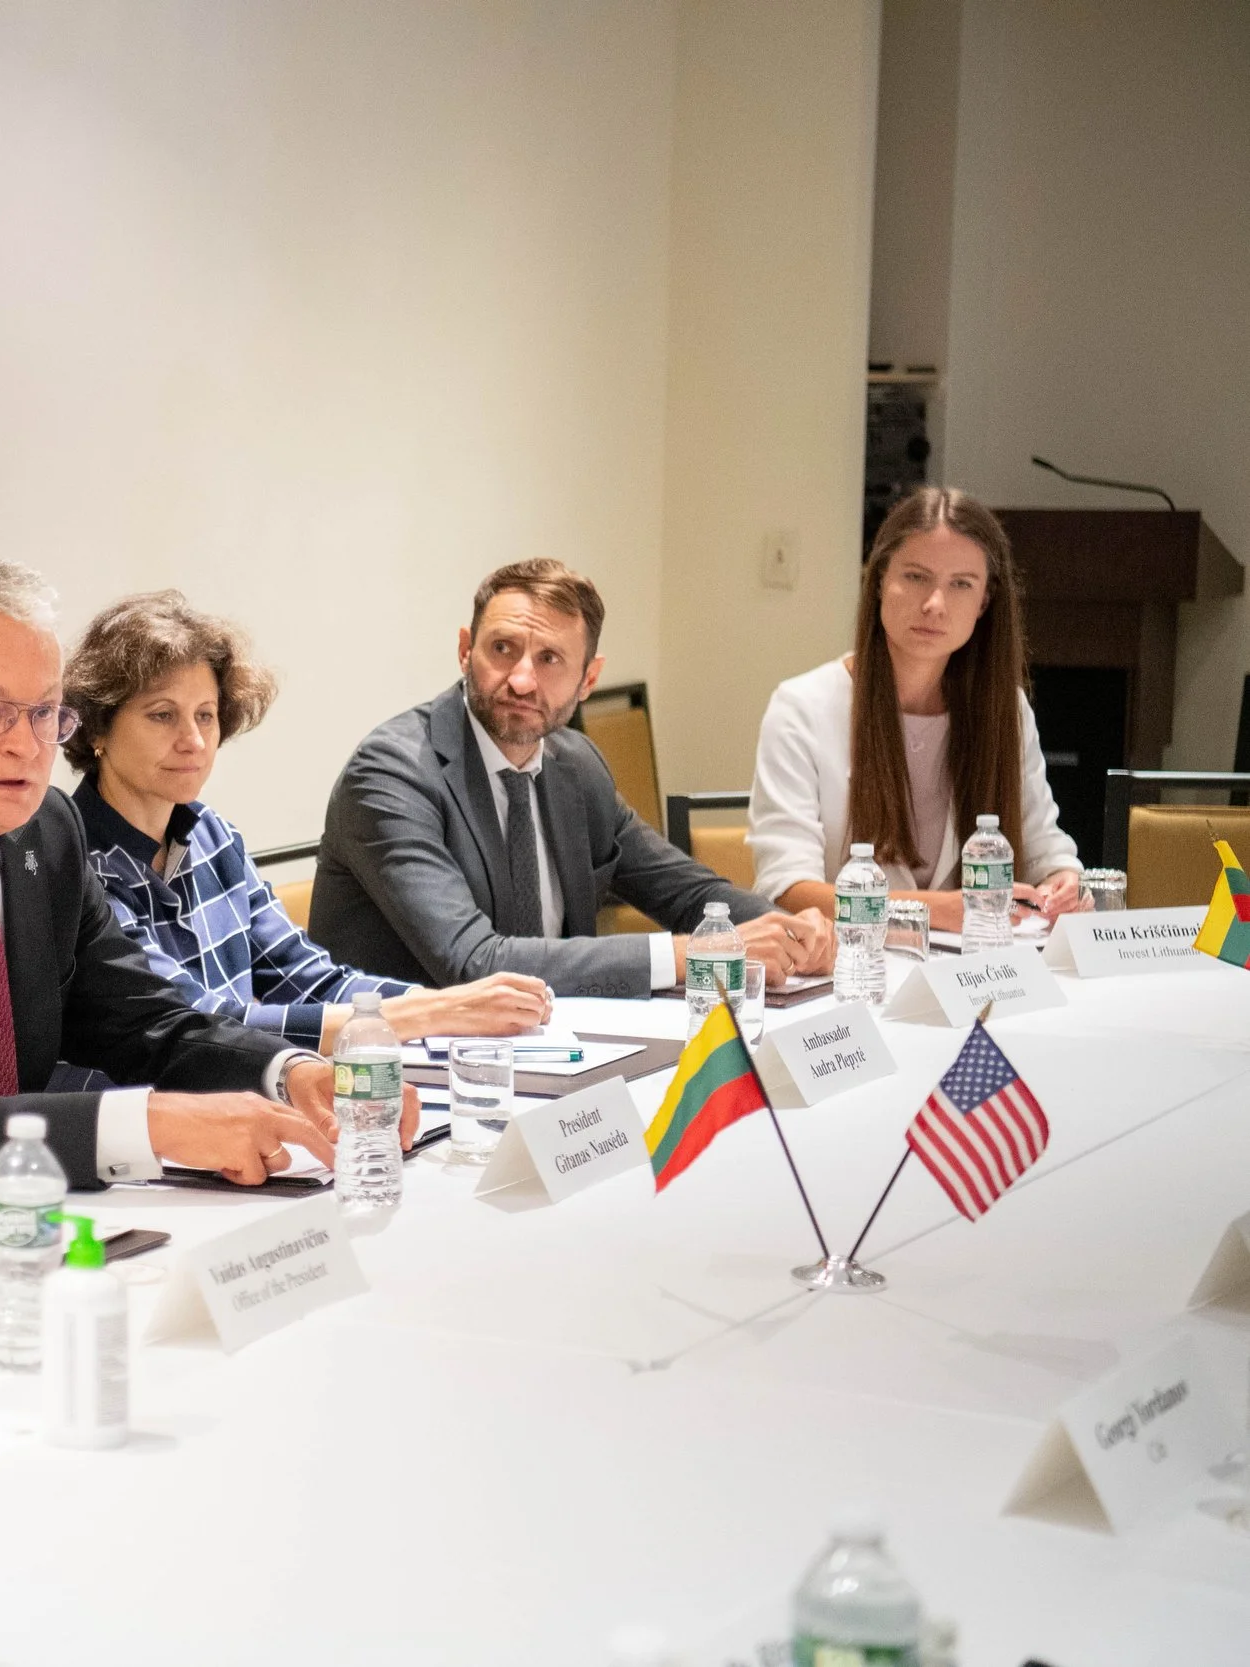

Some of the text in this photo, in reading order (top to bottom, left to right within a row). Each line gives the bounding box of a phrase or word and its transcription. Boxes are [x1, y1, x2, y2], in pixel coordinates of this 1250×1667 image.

[1092, 923, 1201, 942] Rūta Kriščiūnai
[1118, 947, 1150, 960] Invest
[956, 971, 987, 989] Elijus
[802, 1024, 852, 1053] Ambassador
[809, 1058, 838, 1080] Audra
[558, 1106, 602, 1138] President
[554, 1129, 629, 1175] Gitanas Nausėda
